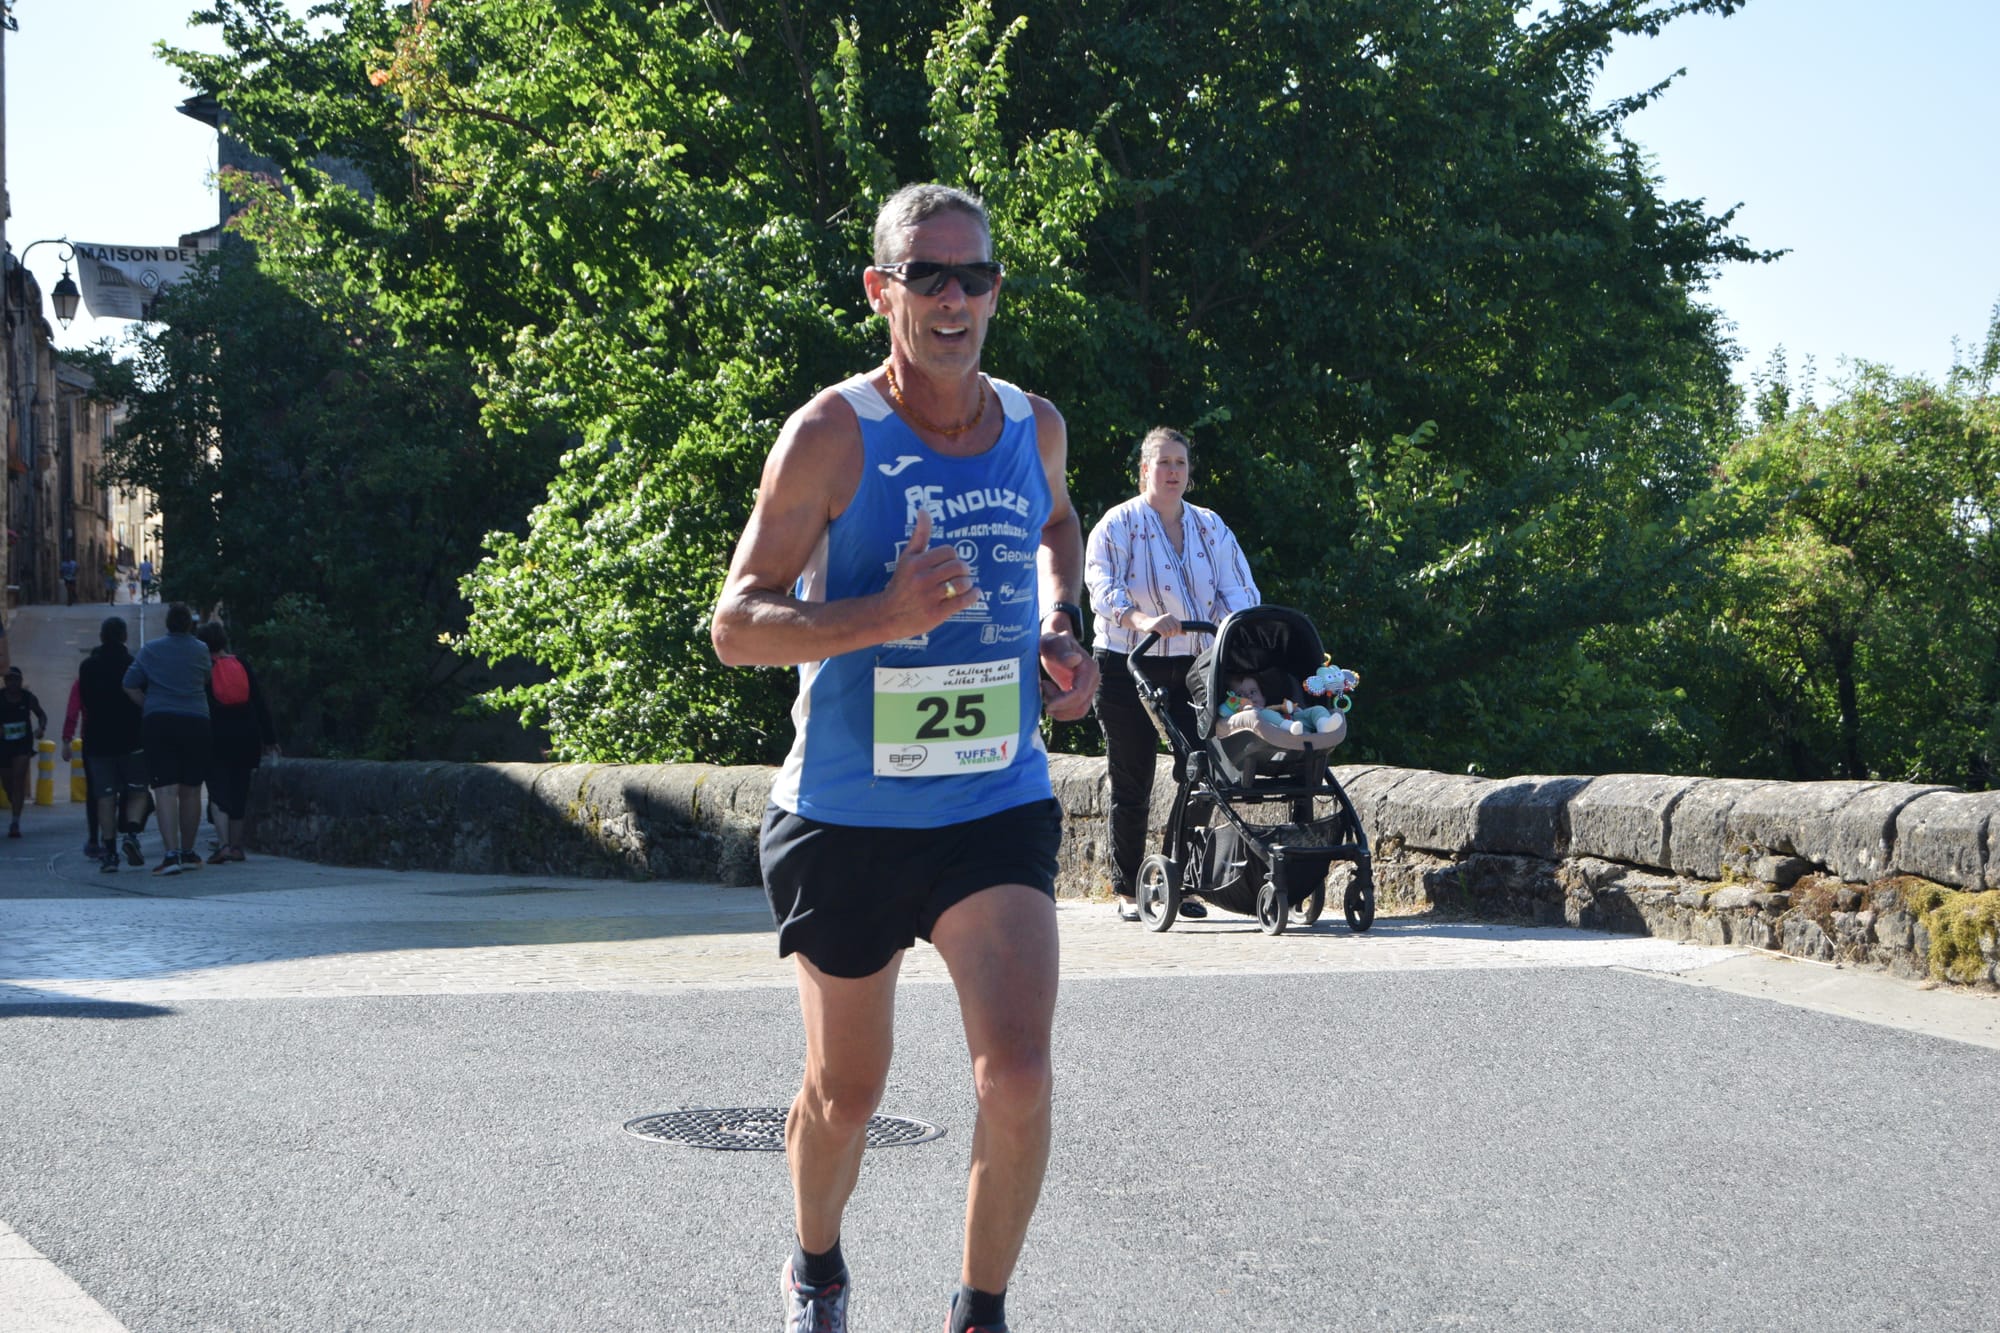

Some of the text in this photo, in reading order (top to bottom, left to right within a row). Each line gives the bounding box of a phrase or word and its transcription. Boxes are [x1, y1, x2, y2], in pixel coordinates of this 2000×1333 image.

[80, 247, 158, 262] MAISON
[165, 249, 190, 262] DE
[948, 663, 1010, 677] Challenge des
[916, 693, 986, 740] 25
[955, 747, 997, 759] TUFF'S
